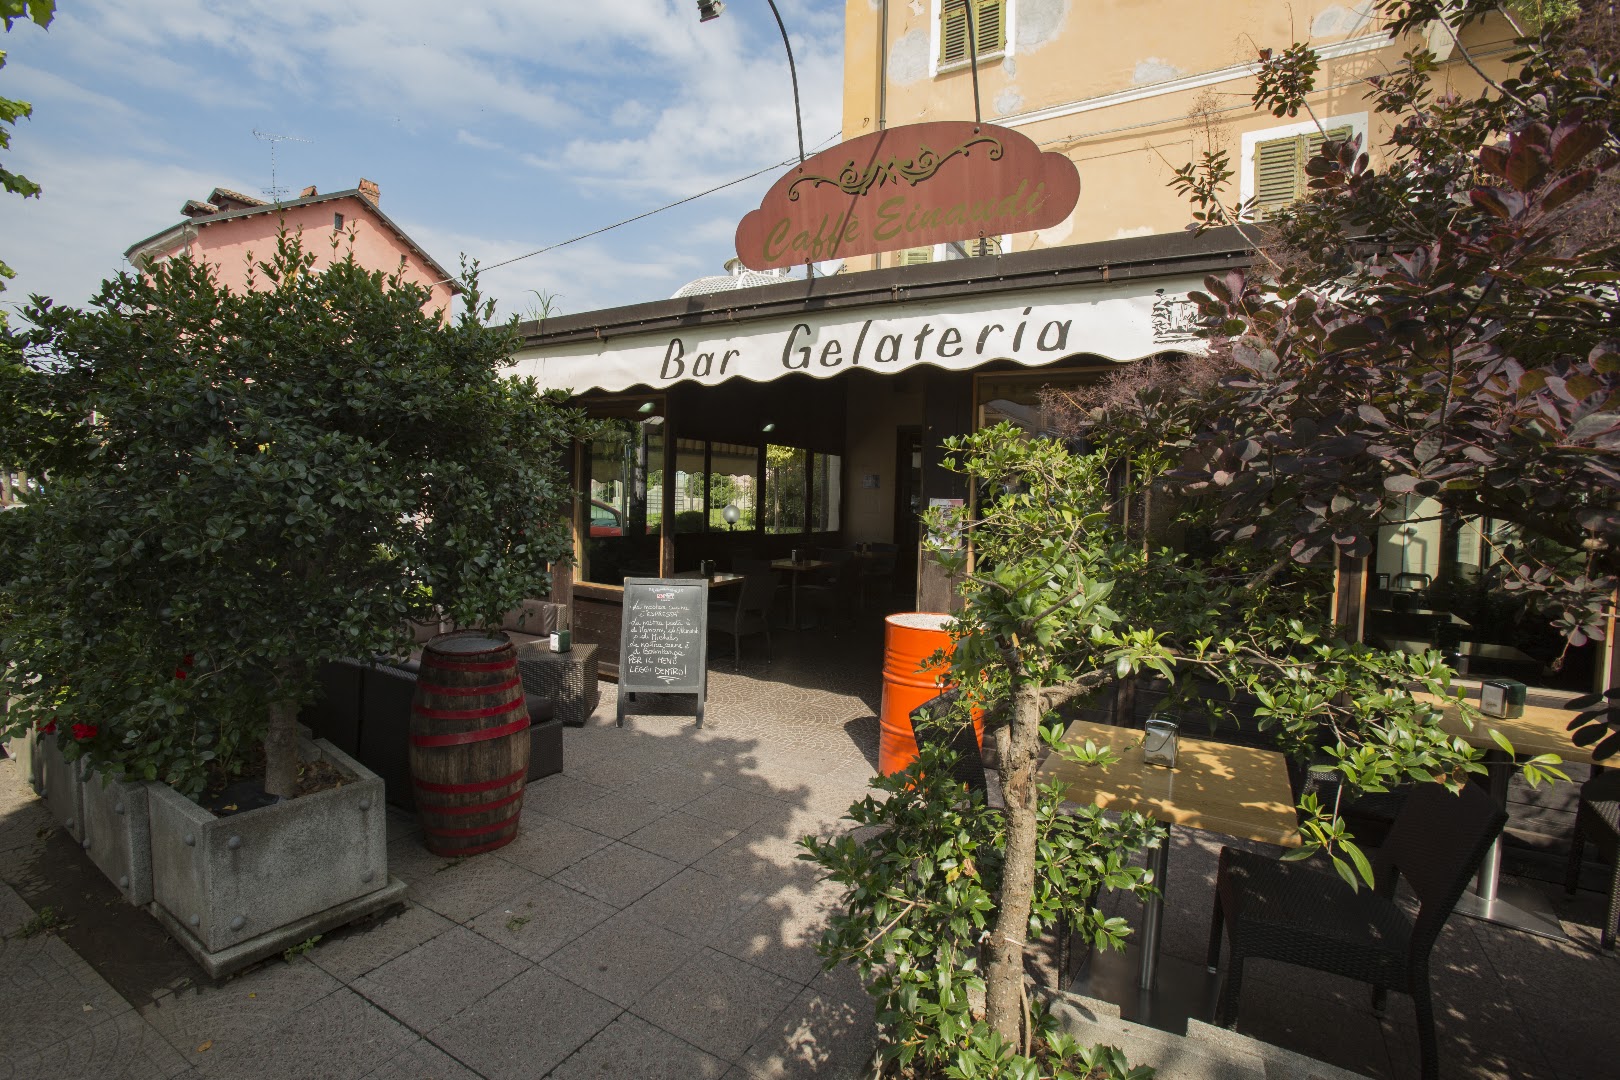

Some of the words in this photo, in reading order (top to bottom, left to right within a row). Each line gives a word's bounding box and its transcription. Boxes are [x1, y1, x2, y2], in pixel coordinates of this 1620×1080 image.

[762, 208, 861, 263] Caffè
[873, 179, 1047, 242] Einaudi
[659, 337, 740, 380] Bar
[782, 306, 1073, 370] Gelateria
[628, 654, 642, 664] PER
[645, 656, 653, 664] IL
[629, 665, 652, 673] LEGGI
